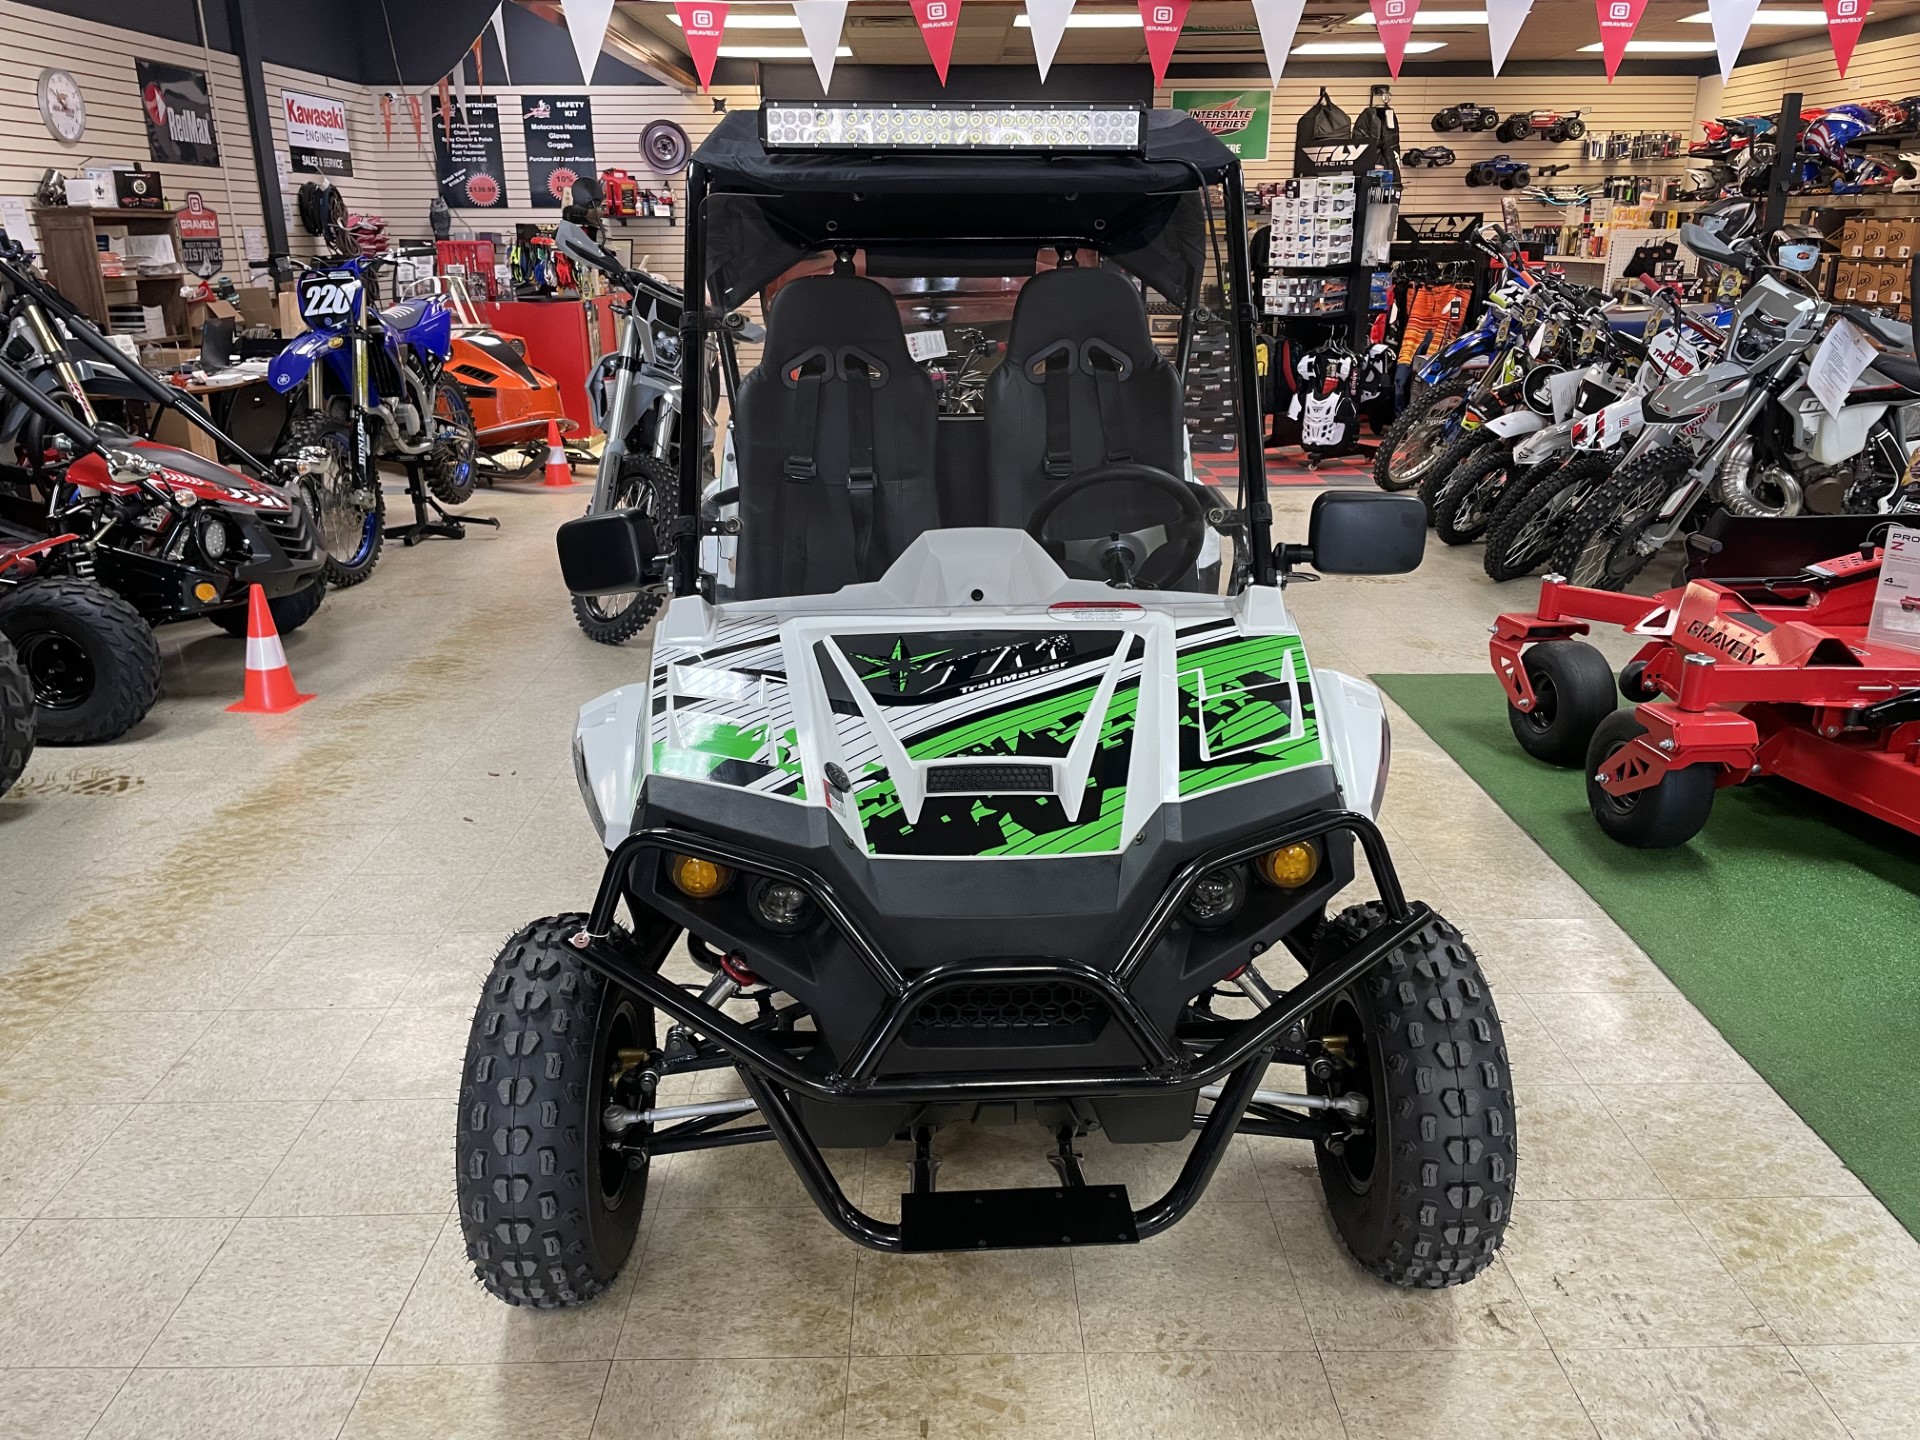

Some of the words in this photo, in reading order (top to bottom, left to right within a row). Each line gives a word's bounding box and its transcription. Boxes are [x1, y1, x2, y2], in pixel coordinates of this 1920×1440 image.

[286, 98, 344, 129] Kawasaki
[1190, 110, 1252, 118] INTERSTATE
[167, 107, 211, 145] RedMax
[305, 130, 333, 144] ENGINES
[1302, 144, 1369, 162] FLY
[302, 155, 319, 167] SALES
[323, 157, 343, 168] SERVICE
[180, 219, 216, 229] GRAVELY
[1404, 216, 1476, 233] FLY
[183, 249, 223, 261] DISTANCE
[304, 284, 352, 316] 220
[1892, 533, 1920, 543] PRO
[1890, 541, 1905, 551] Z
[1687, 620, 1766, 665] GRAVELY
[959, 660, 1068, 694] TrailMaster
